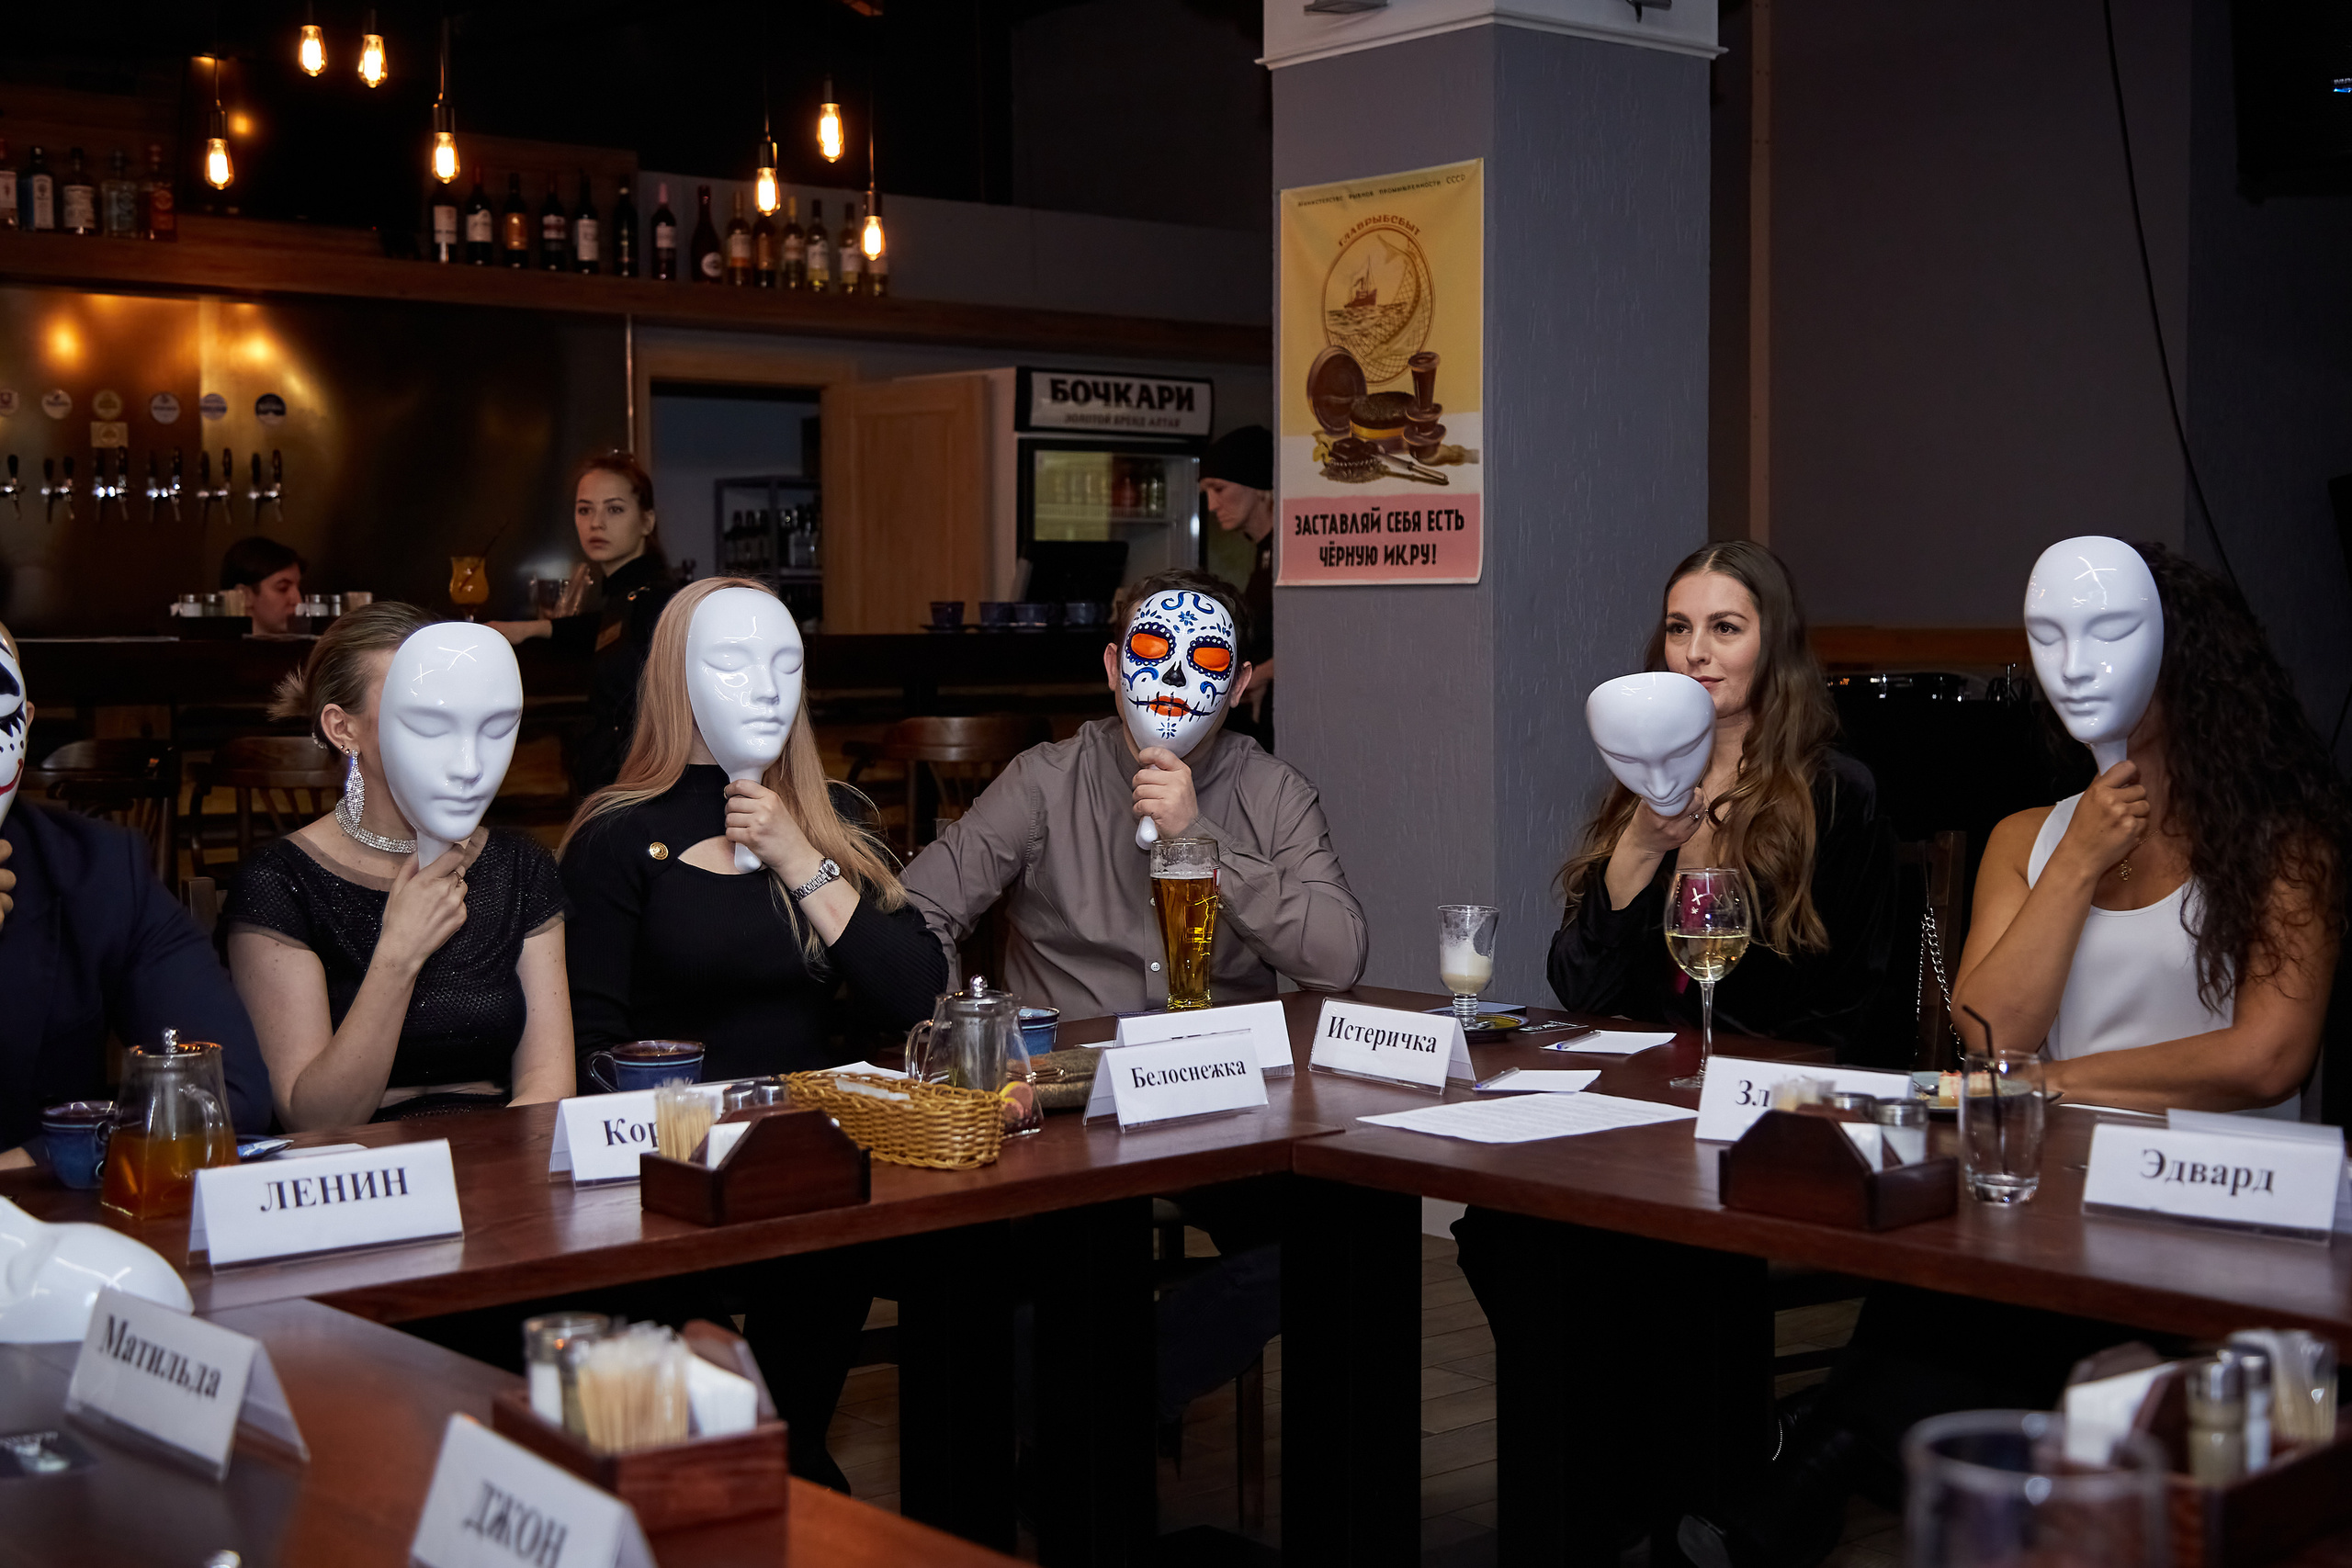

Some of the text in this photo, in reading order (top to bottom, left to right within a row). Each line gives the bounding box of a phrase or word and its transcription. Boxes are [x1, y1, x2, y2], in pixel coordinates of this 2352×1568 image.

[1339, 214, 1421, 247] ГЛАВРЫБСБЫТ
[1050, 378, 1195, 412] БОЧКАРИ
[1295, 506, 1464, 536] ЗАСТАВЛЯЙ СЕБЯ ЕСТЬ
[1319, 541, 1437, 567] ЧЁРНУЮ ИКРУ!
[1328, 1015, 1438, 1054] Истеричка
[1129, 1059, 1248, 1089] Белоснежка
[260, 1167, 409, 1213] ЛЕНИН
[2140, 1148, 2275, 1197] Эдвард
[99, 1314, 222, 1399] Матильда
[461, 1478, 569, 1568] ДЖОН
